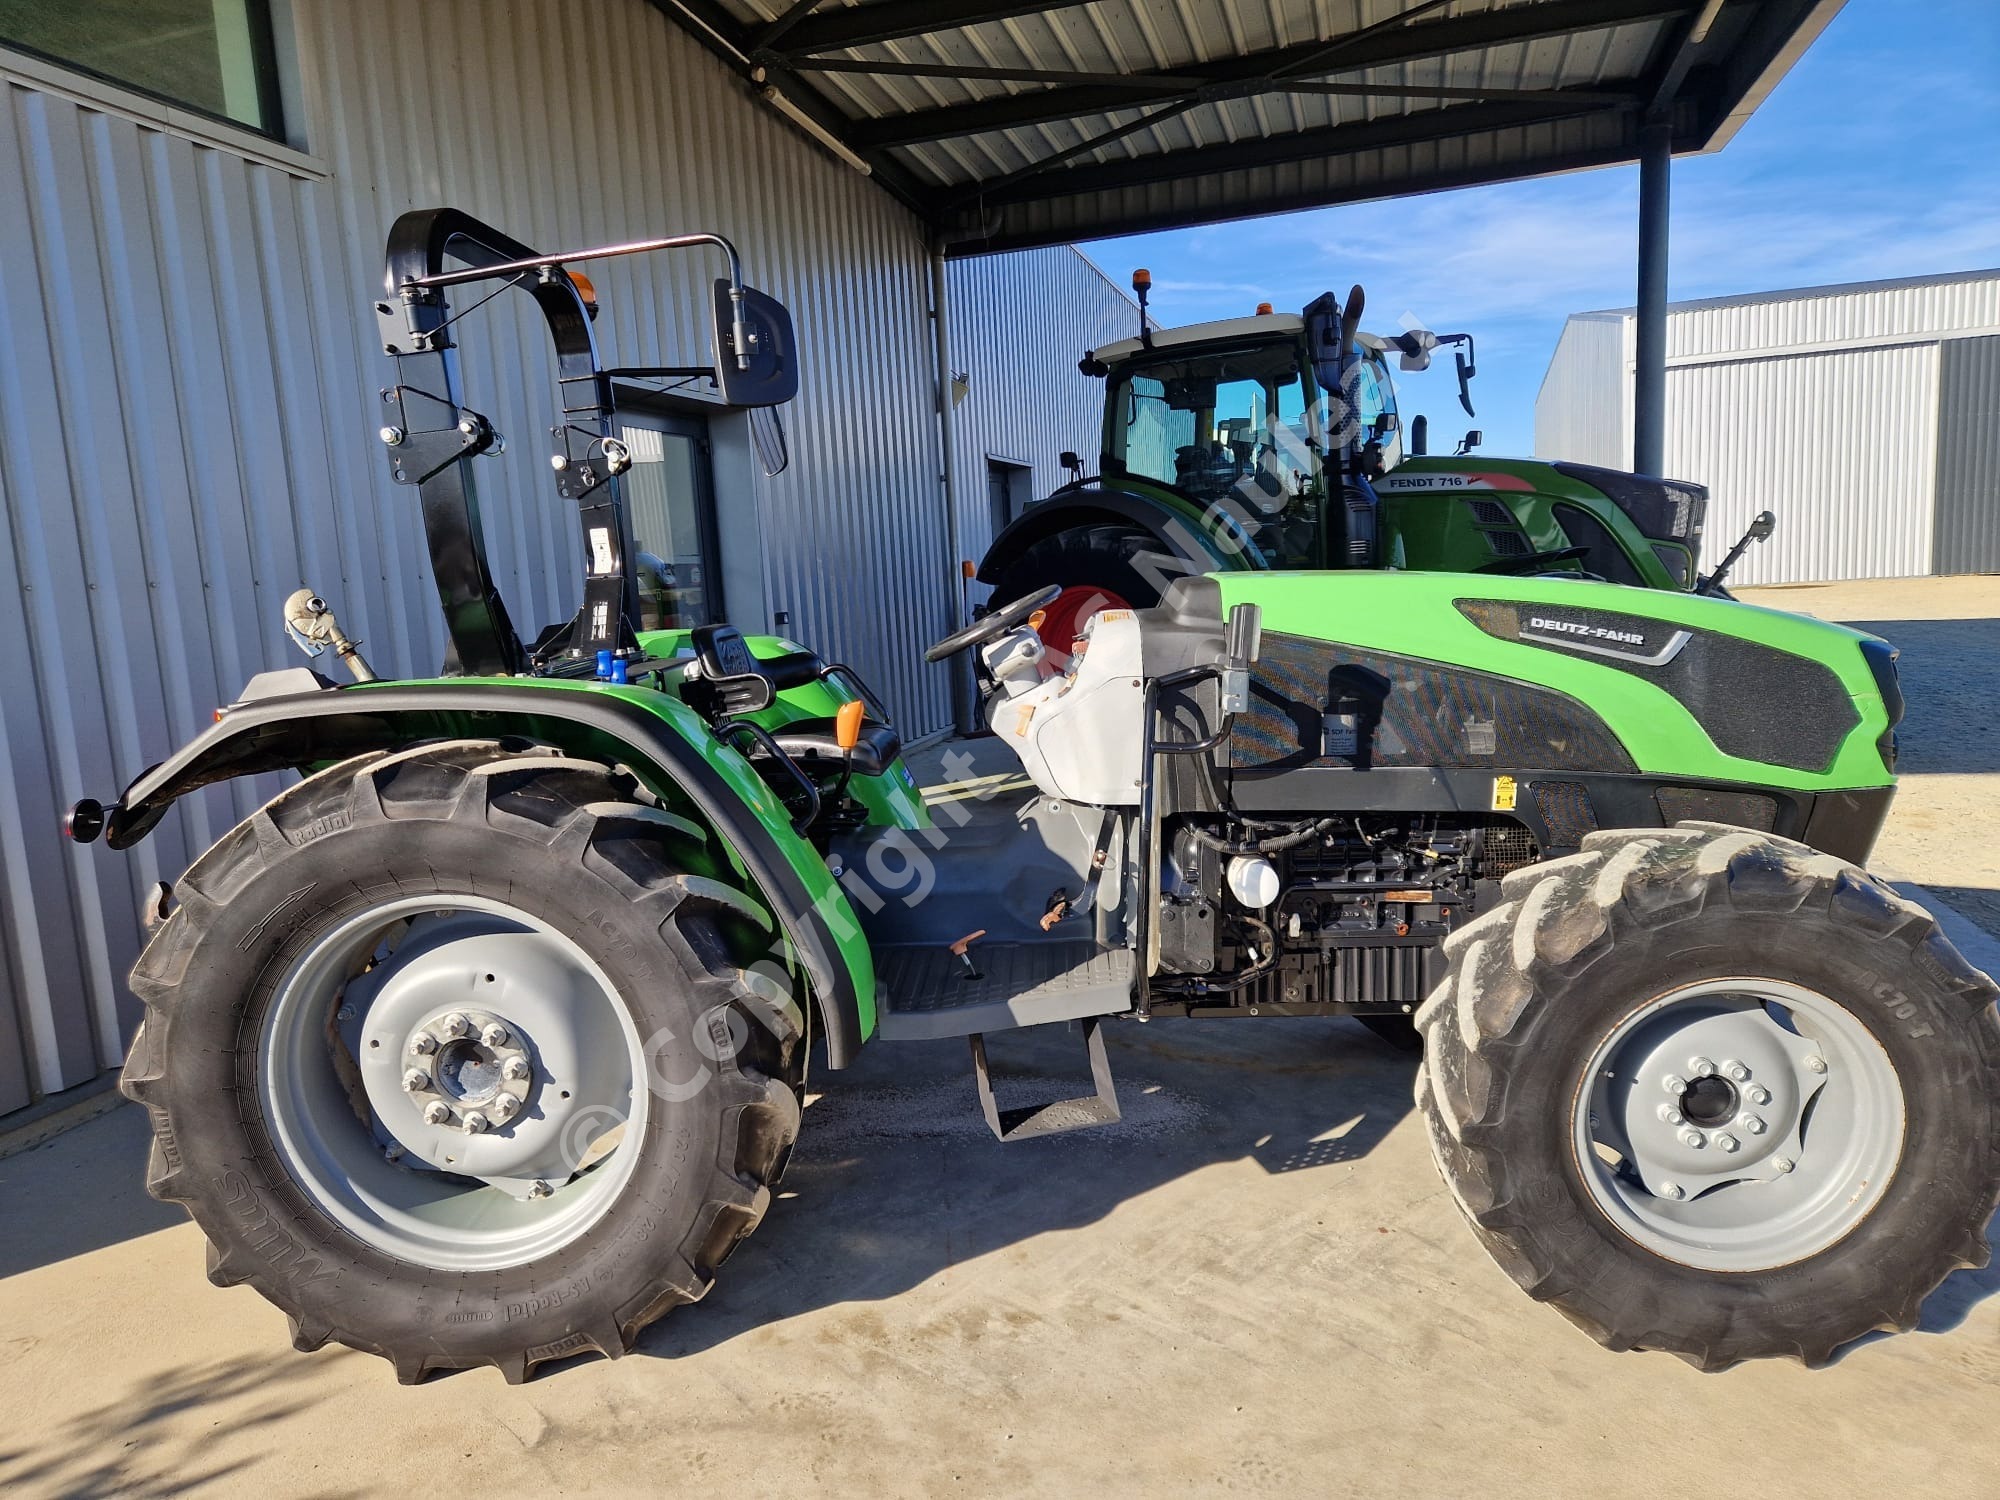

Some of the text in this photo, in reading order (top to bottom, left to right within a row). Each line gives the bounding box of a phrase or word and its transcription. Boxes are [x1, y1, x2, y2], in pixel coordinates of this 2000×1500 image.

[1389, 479, 1434, 489] FENDT
[1438, 477, 1462, 487] 716
[1530, 617, 1645, 646] DEUTZ-FAHR
[291, 810, 353, 848] Radial
[1858, 970, 1918, 1020] AC70
[503, 1276, 592, 1322] AS-Radial
